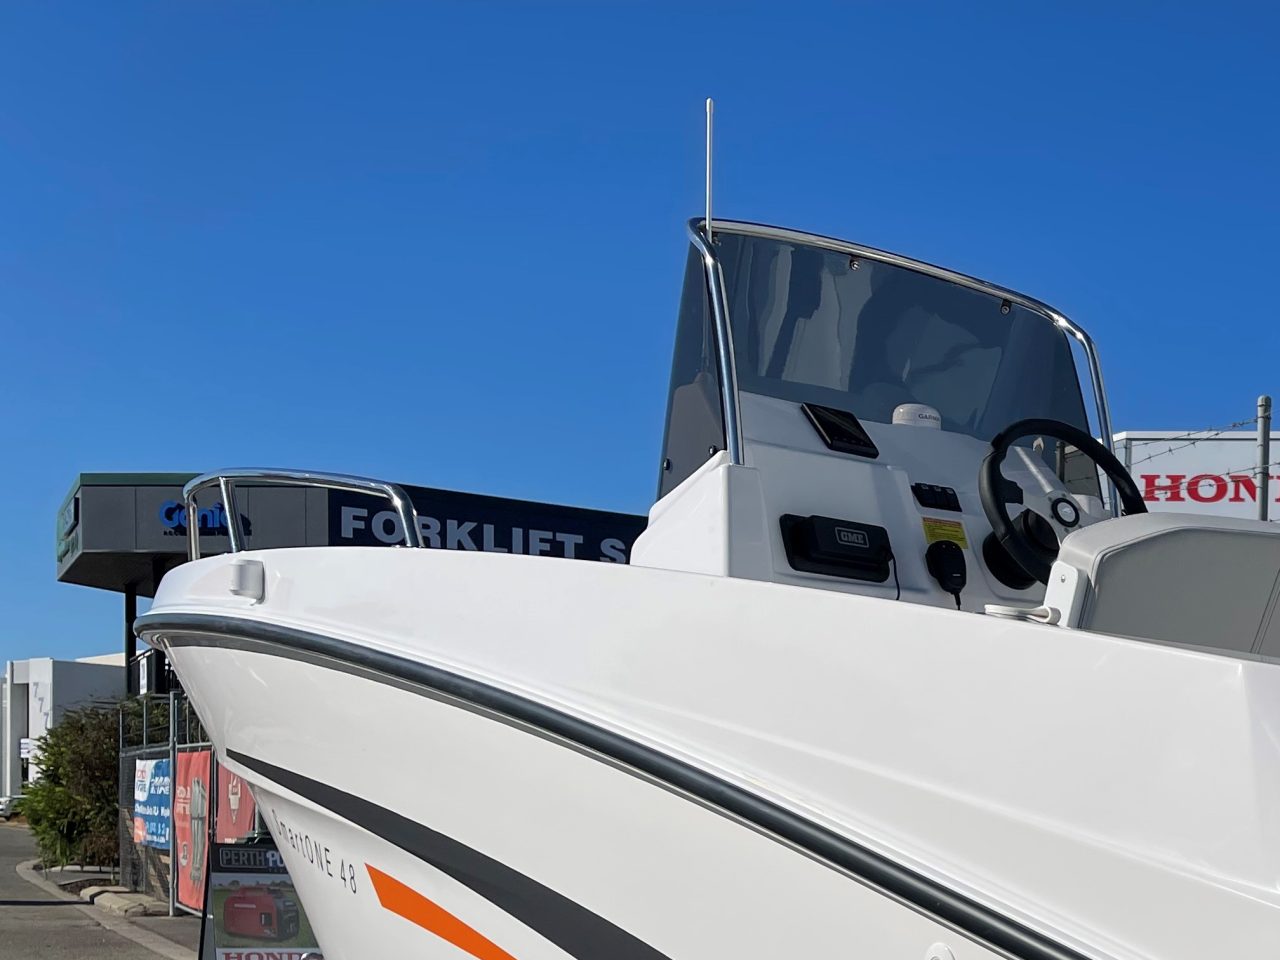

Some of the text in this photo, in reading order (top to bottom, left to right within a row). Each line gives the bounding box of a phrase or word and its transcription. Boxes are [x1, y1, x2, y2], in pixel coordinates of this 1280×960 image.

[341, 506, 584, 561] FORKLIFT
[222, 850, 265, 867] PERTH
[340, 858, 357, 894] 48
